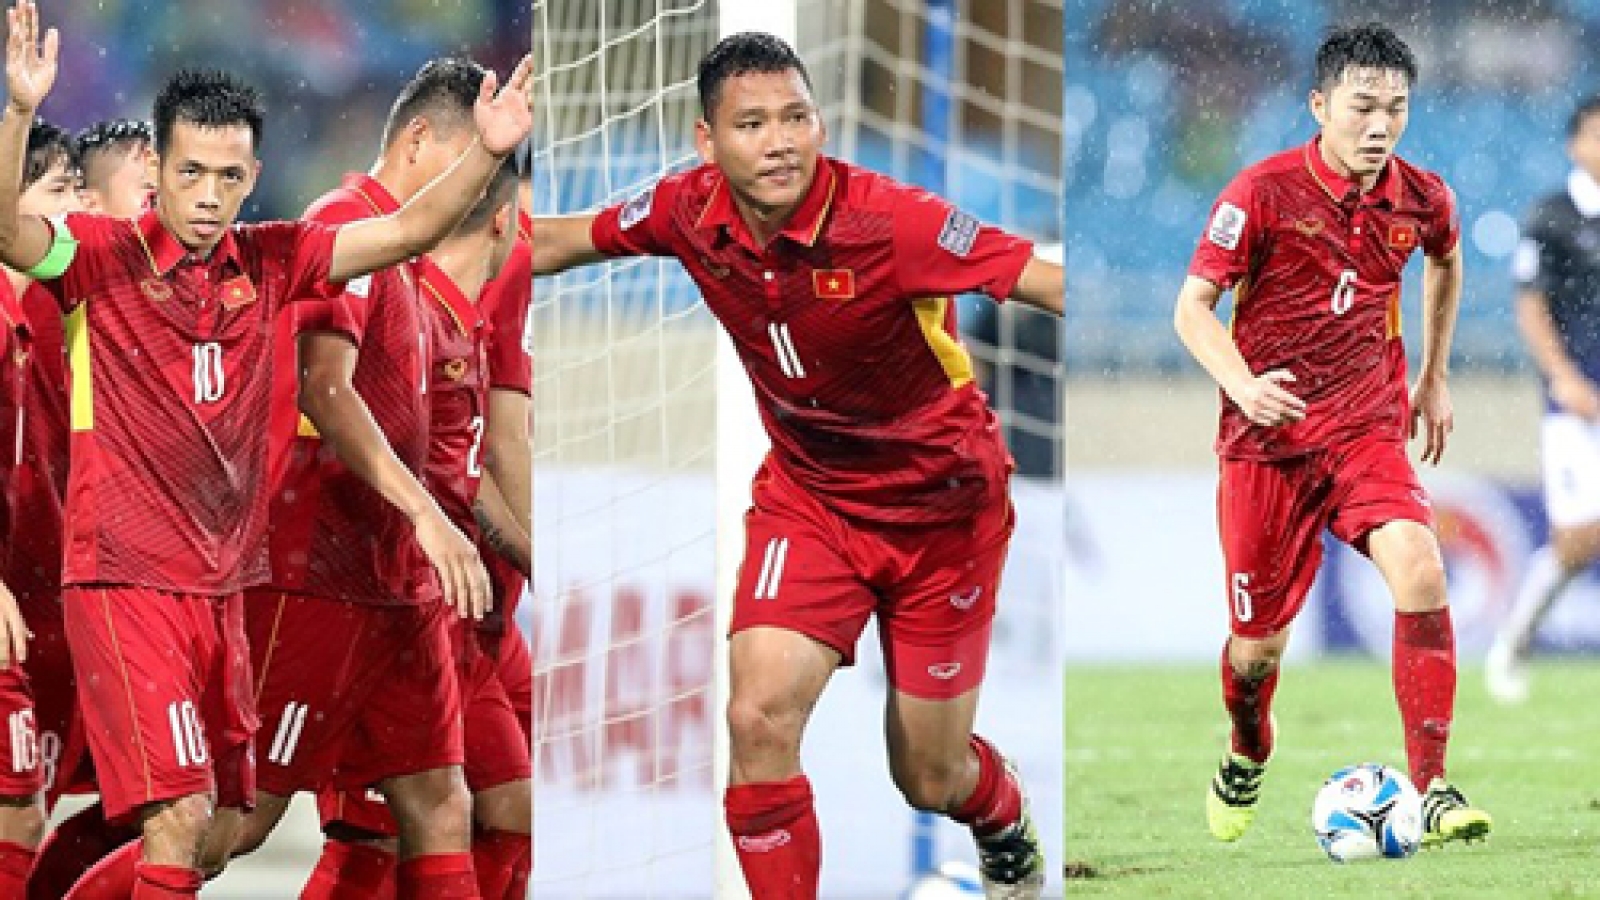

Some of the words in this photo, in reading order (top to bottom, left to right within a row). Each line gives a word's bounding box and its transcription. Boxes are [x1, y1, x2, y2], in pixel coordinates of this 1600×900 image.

[1332, 269, 1358, 315] 6
[191, 342, 225, 404] 10
[766, 322, 807, 379] 11
[753, 537, 788, 600] 11
[1234, 574, 1253, 622] 6
[9, 708, 37, 772] 16
[168, 701, 208, 766] 10
[268, 701, 308, 766] 11
